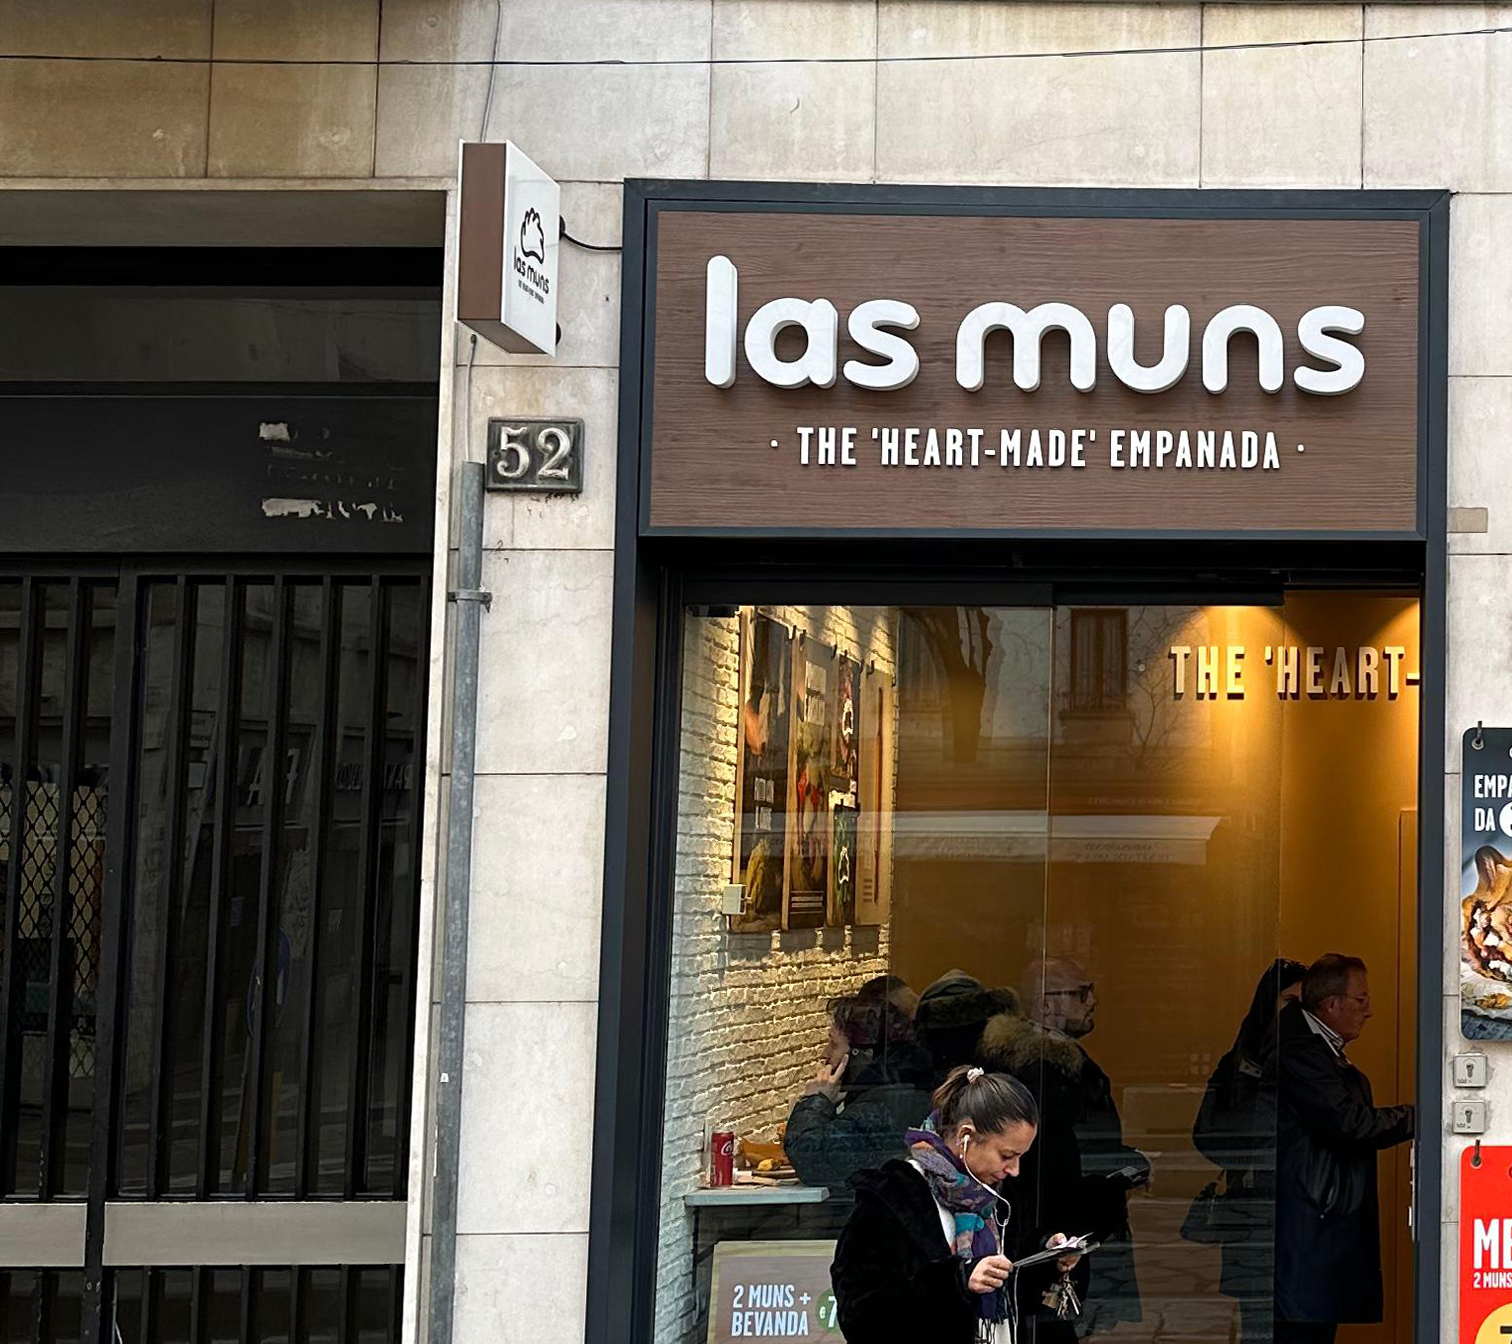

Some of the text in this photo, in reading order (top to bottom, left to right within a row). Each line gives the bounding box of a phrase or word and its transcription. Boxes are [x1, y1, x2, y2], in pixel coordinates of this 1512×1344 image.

[513, 246, 526, 276] las
[704, 255, 1366, 396] las muns
[496, 425, 572, 481] 52
[796, 425, 1282, 471] THE 'HEART-MADE' EMPANADA
[1169, 645, 1246, 695] THE
[1264, 645, 1420, 696] 'HEART-
[1474, 808, 1496, 832] DA
[1473, 1272, 1481, 1289] 2
[732, 1284, 745, 1309] 2
[748, 1284, 795, 1309] MUNS
[731, 1310, 809, 1337] BEVANDA
